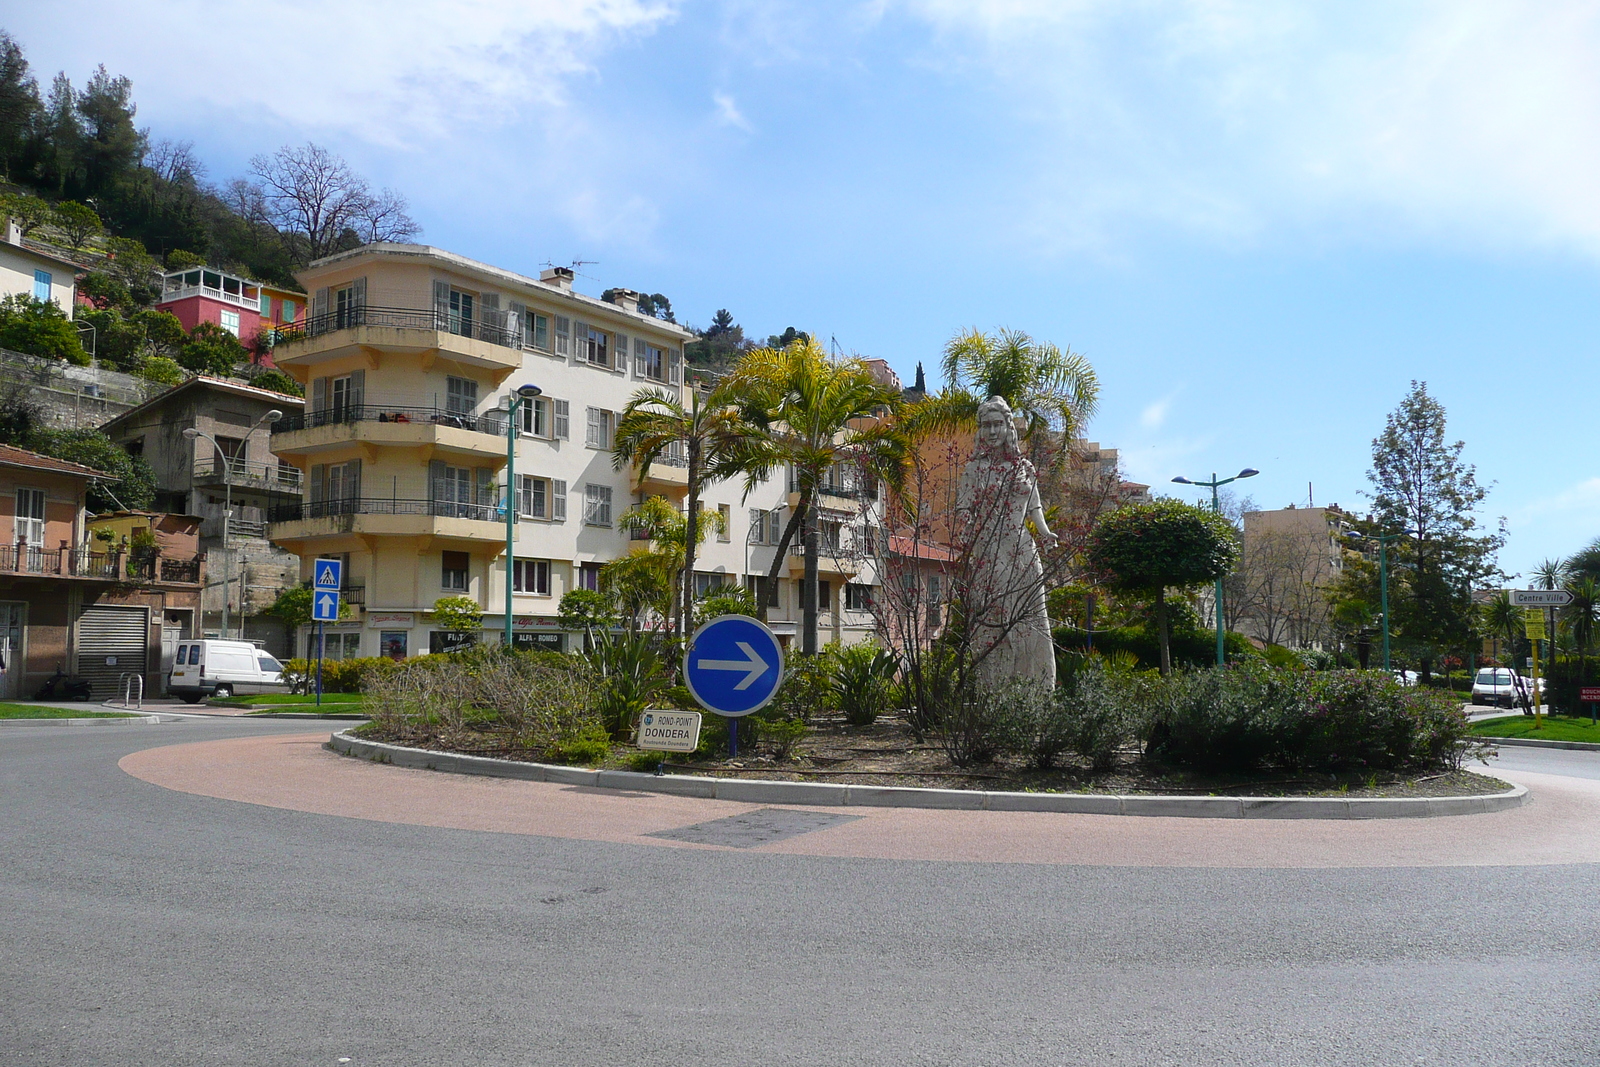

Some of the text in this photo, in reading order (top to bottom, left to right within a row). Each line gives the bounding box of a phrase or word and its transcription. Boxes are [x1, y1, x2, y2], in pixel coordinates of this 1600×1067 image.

[1518, 594, 1564, 602] Centre Ville
[518, 634, 533, 642] ALFA
[538, 634, 558, 642] ROMEO
[657, 716, 693, 727] ROND-POINT
[644, 728, 690, 739] DONDERA
